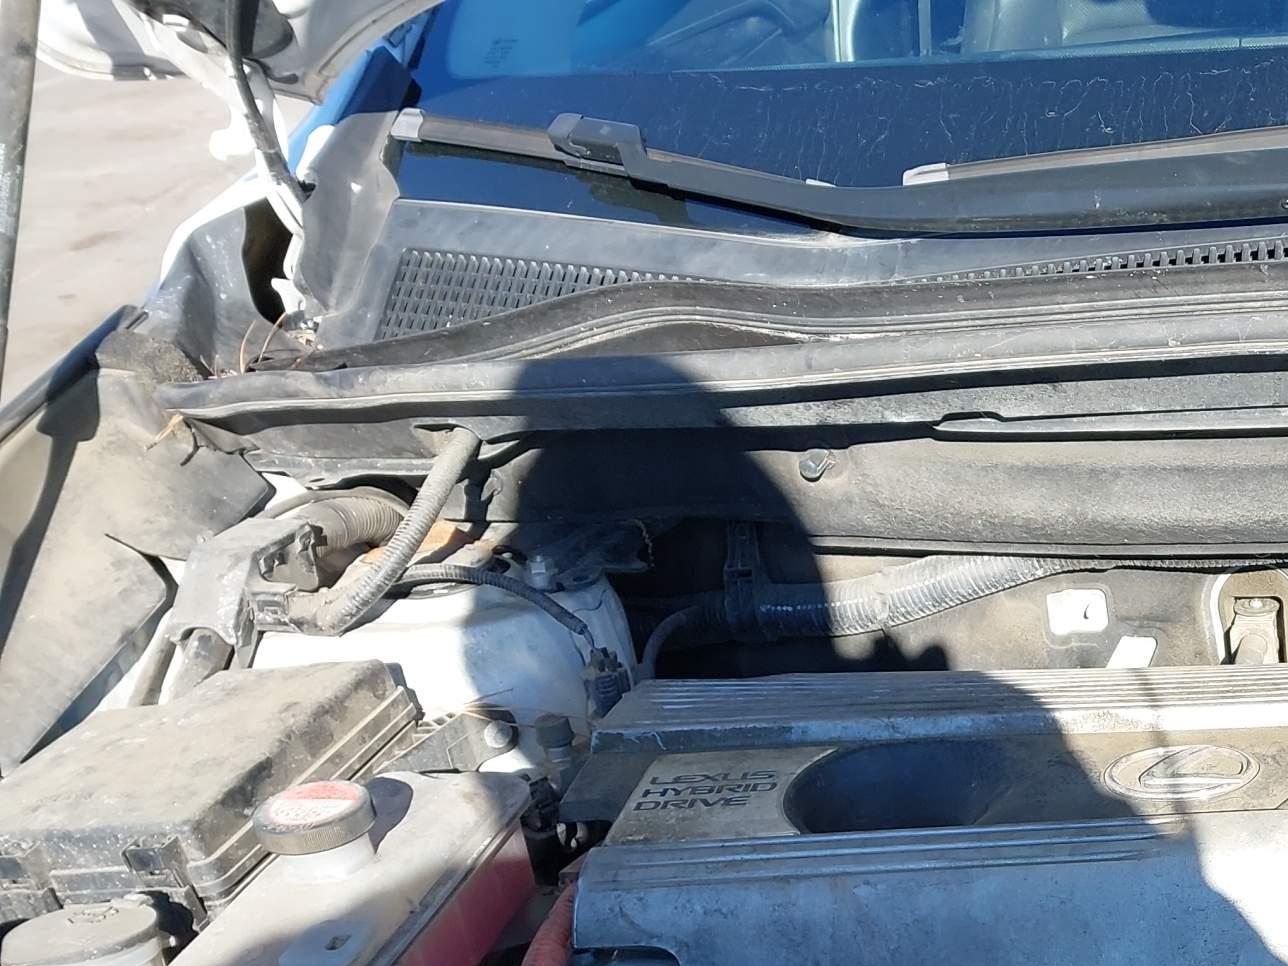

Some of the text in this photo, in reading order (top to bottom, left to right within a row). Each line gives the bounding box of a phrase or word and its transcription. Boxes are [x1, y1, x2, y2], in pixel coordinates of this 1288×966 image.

[650, 770, 777, 785] LEXUS
[641, 782, 779, 798] HYBRID
[632, 795, 752, 811] DRIVE
